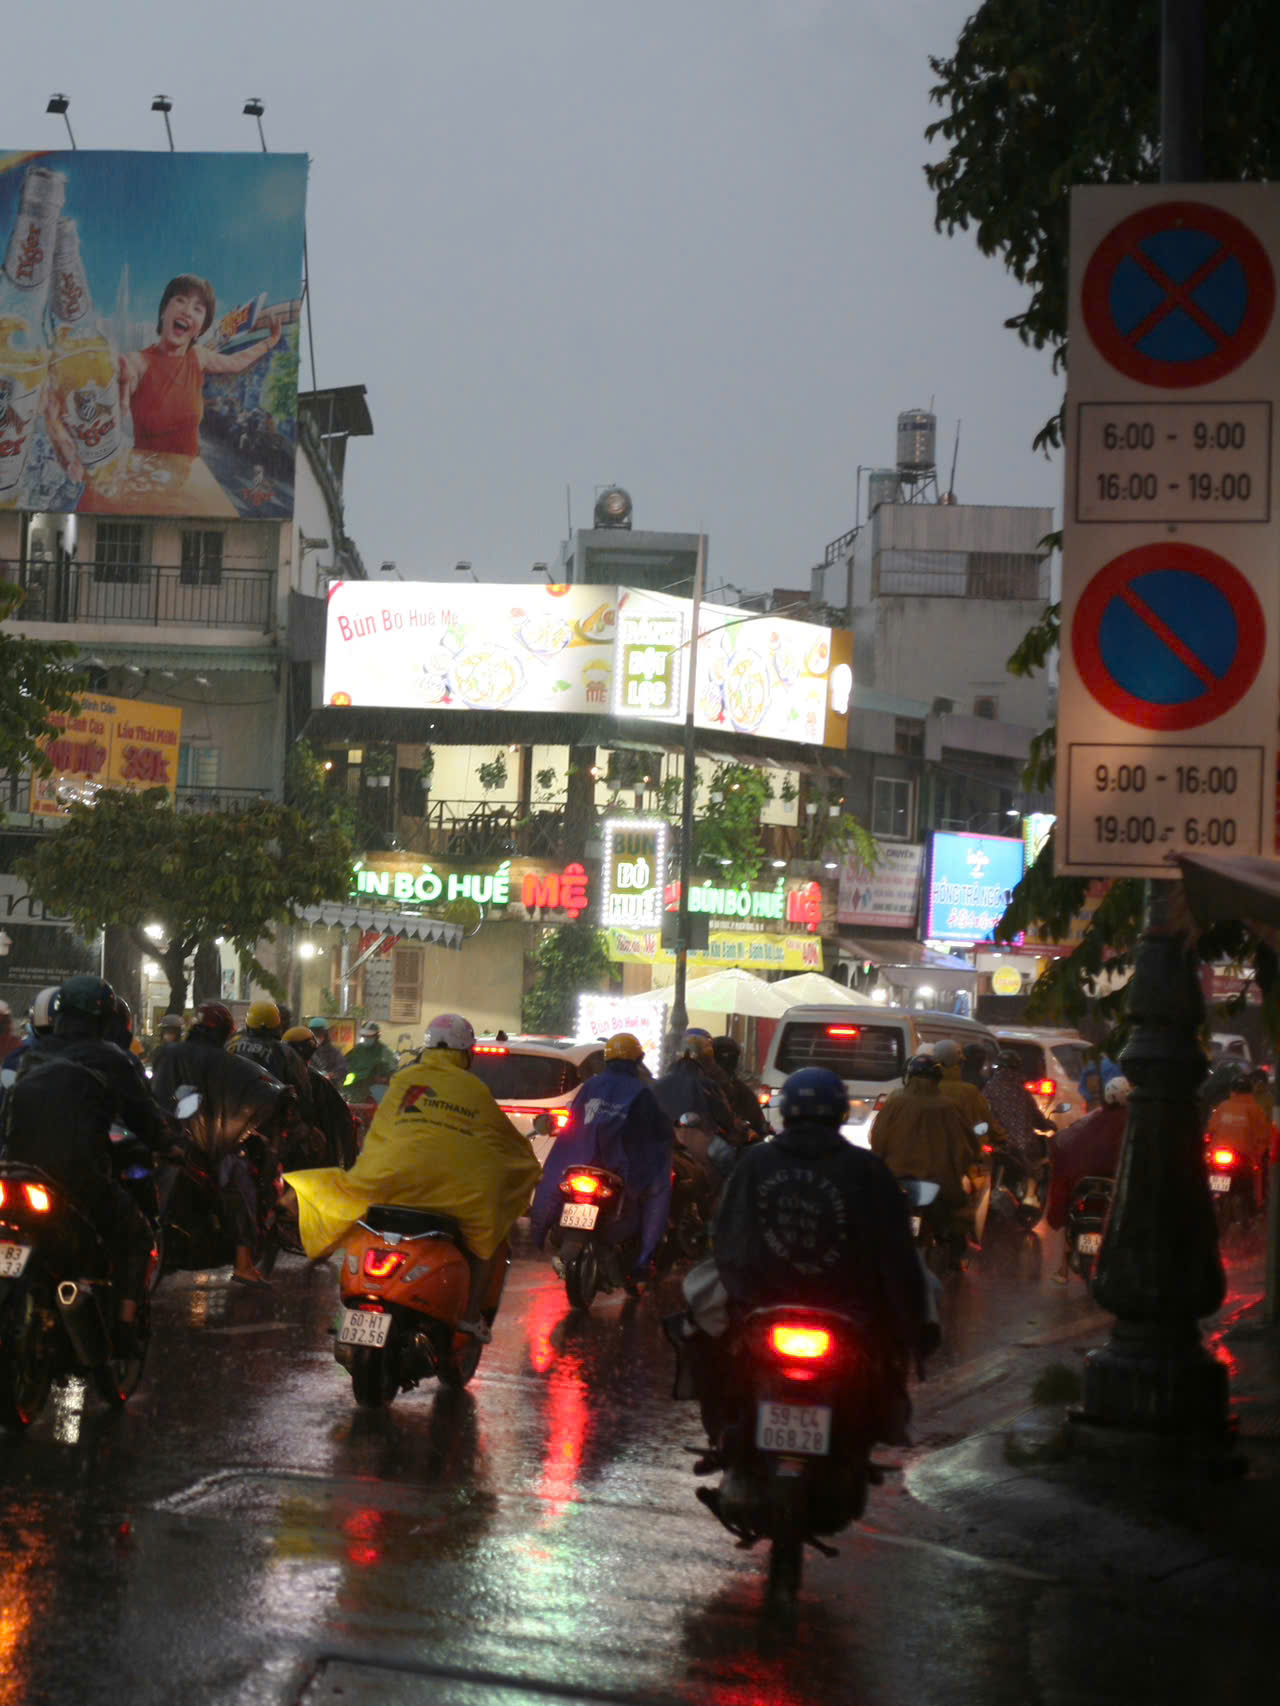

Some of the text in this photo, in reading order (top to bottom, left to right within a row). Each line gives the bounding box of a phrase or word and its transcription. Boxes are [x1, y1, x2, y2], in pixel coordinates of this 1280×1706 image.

[16, 223, 44, 280] Tiger
[62, 416, 116, 447] Tiger
[1103, 421, 1155, 450] 6:00
[1193, 421, 1245, 451] 9:00
[1097, 471, 1158, 501] 16:00
[1189, 471, 1252, 501] 19:00
[1095, 764, 1146, 792] 9:00
[1176, 766, 1237, 795] 16:00
[1094, 815, 1155, 844] 19:00
[1184, 818, 1237, 846] 6:00
[616, 857, 650, 888] BÒ
[394, 864, 443, 901] BÒ
[447, 861, 512, 904] HUẾ
[521, 863, 588, 919] MỆ
[688, 879, 724, 914] BÚN
[726, 882, 752, 917] BÒ
[752, 877, 785, 920] HUẾ
